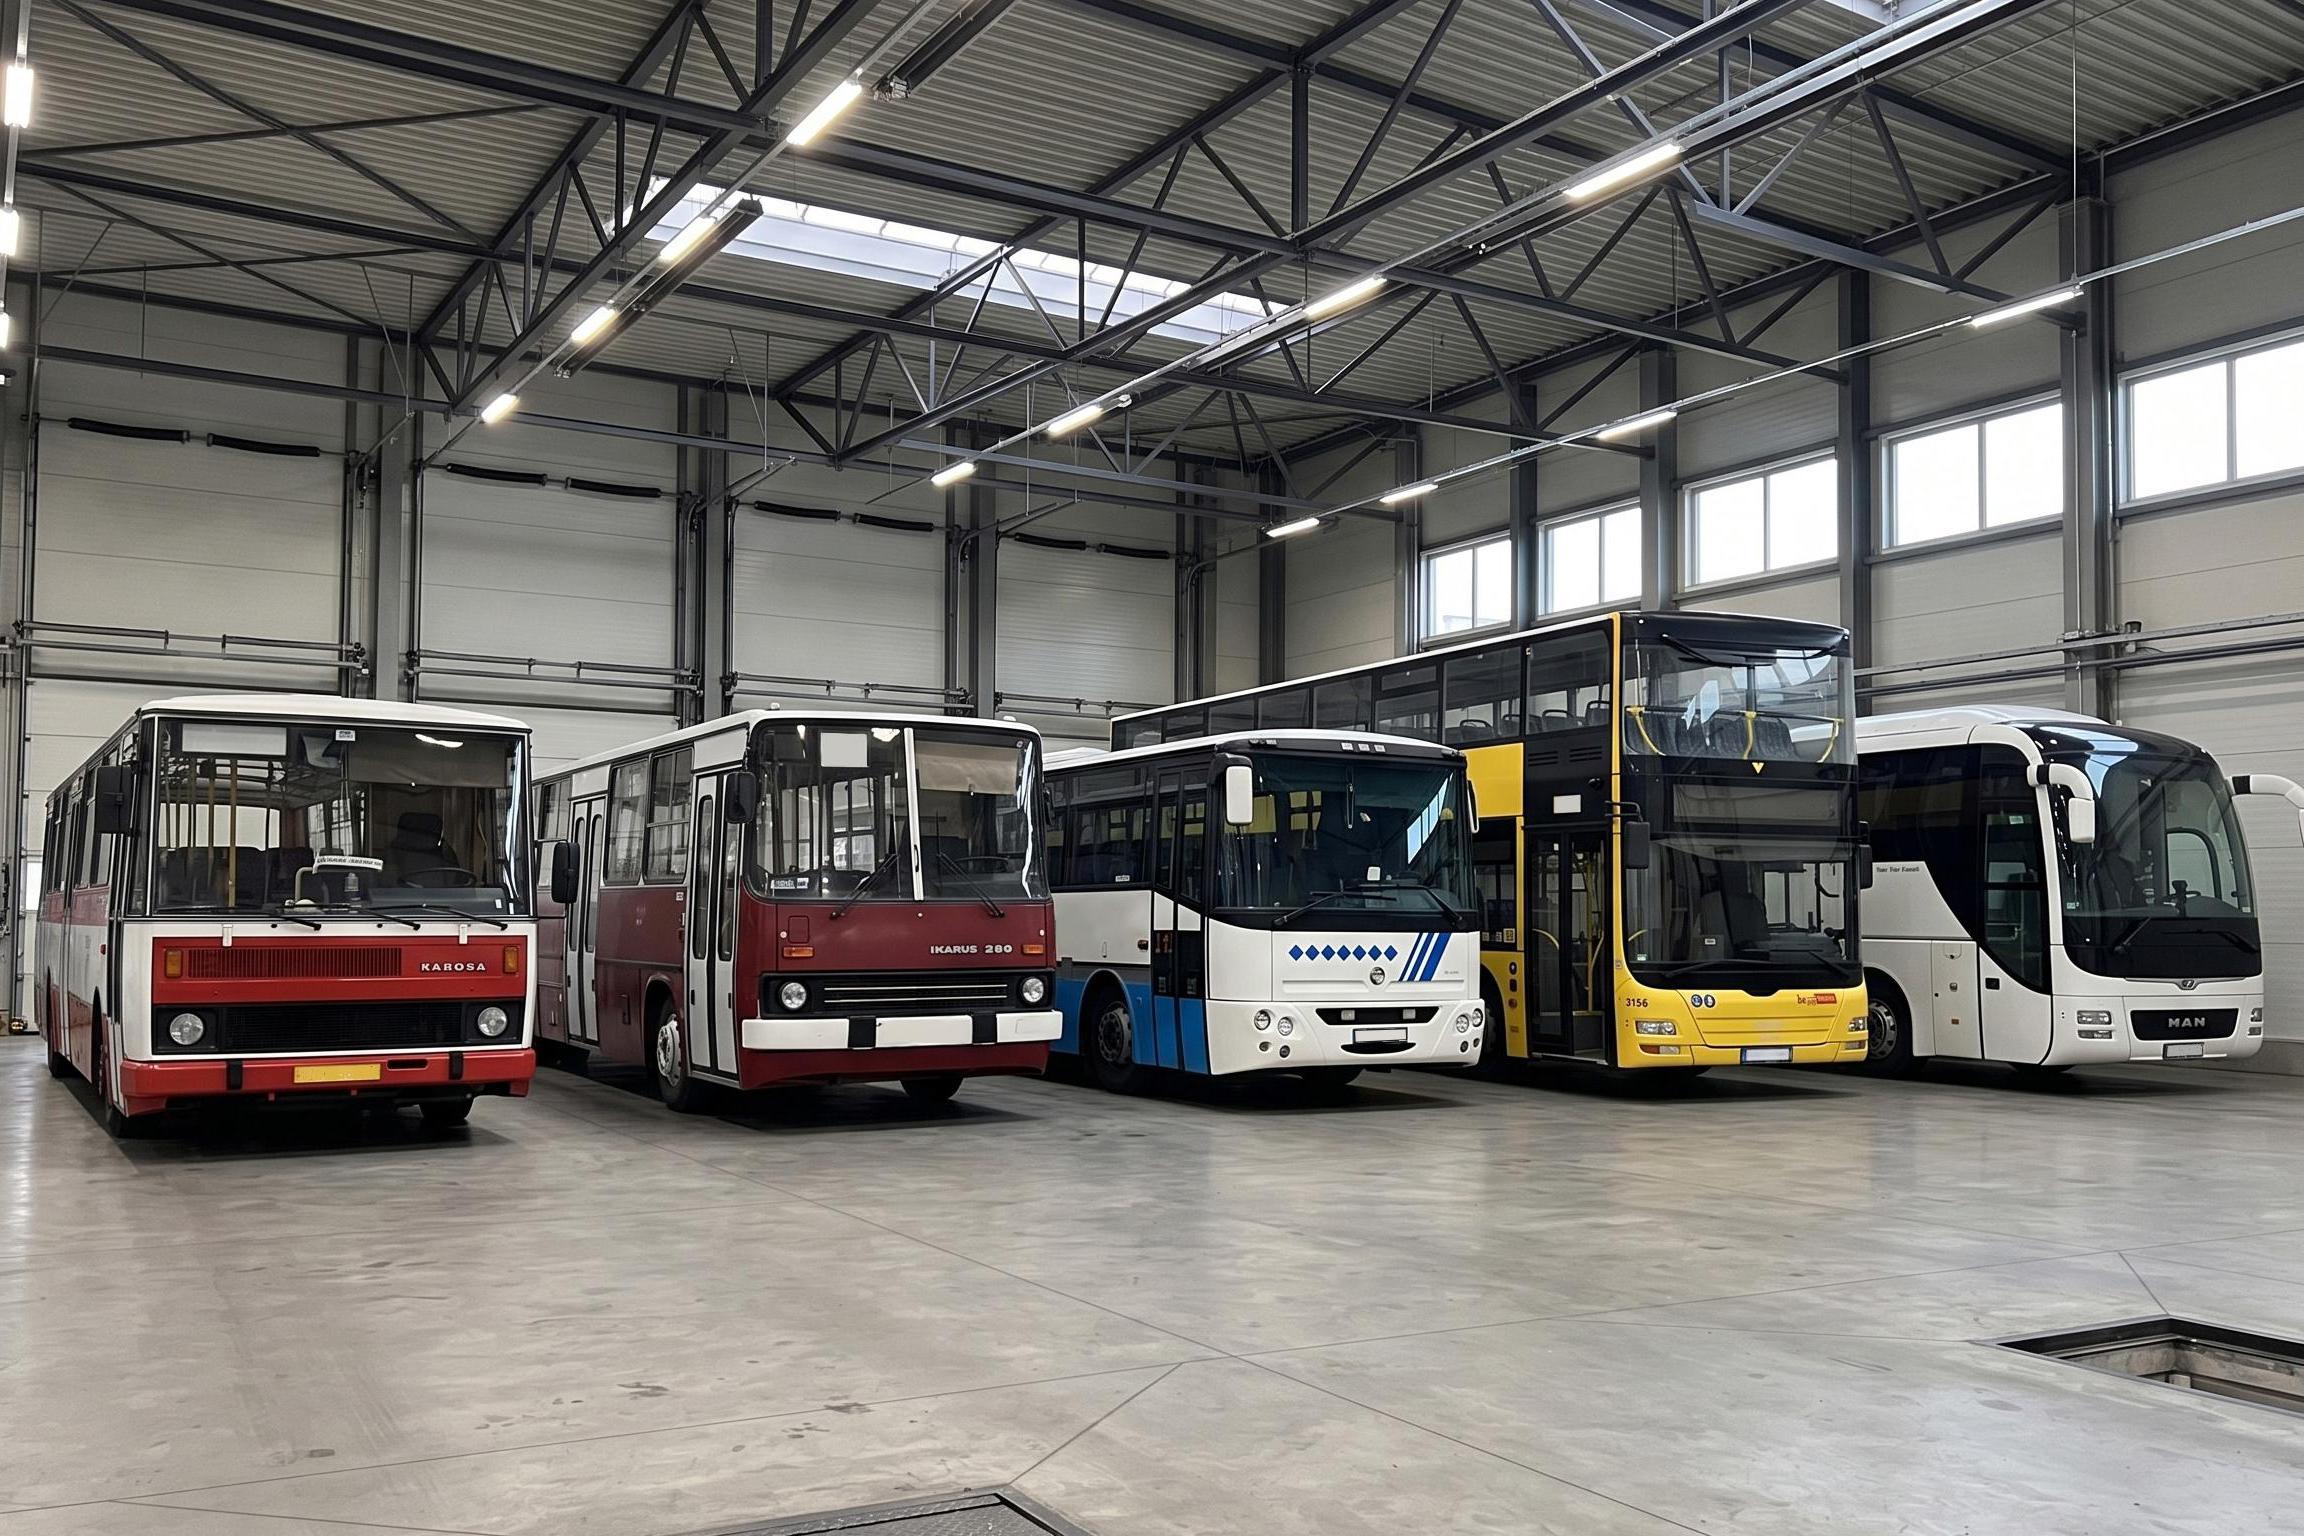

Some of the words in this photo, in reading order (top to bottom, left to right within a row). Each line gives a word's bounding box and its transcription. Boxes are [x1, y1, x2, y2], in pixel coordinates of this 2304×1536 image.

[930, 945, 978, 954] IKARUS
[985, 944, 1013, 954] 280
[421, 962, 486, 971] KAROSA
[1625, 998, 1648, 1008] 3156
[2168, 1017, 2206, 1028] MAN
